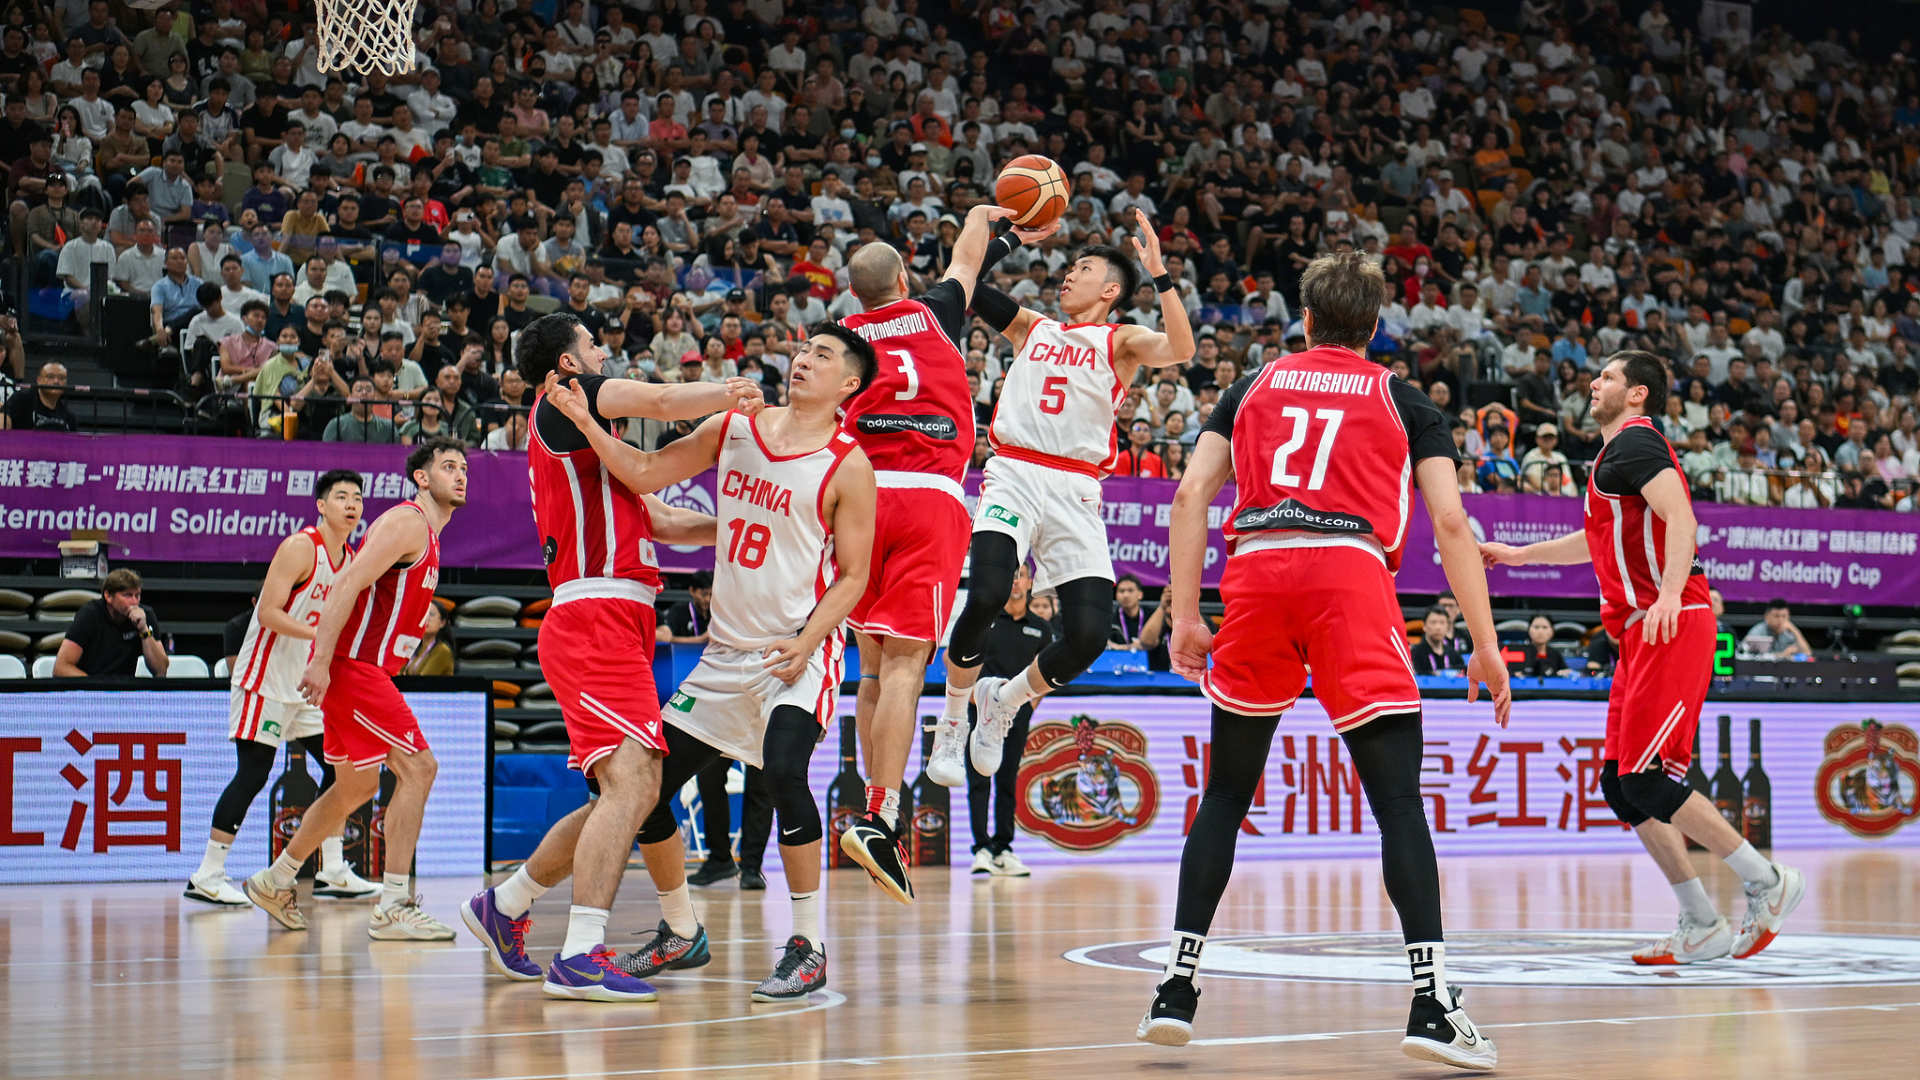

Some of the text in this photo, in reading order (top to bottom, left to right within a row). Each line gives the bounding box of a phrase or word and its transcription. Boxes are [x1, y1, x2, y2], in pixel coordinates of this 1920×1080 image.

[886, 349, 919, 401] 3
[1029, 342, 1096, 371] CHNA
[1039, 376, 1068, 415] 5
[1270, 370, 1374, 396] MAZIASHVILI
[867, 418, 950, 433] adjarabet.com
[1270, 406, 1345, 490] 27
[722, 469, 793, 517] CHINA
[1247, 507, 1360, 530] adjarabet.com
[728, 517, 772, 570] 18
[1759, 559, 1842, 589] Solidarity
[1848, 562, 1882, 589] Cup
[1714, 632, 1735, 676] 2
[1173, 936, 1204, 983] ELIT
[1407, 946, 1436, 1000] ELIT
